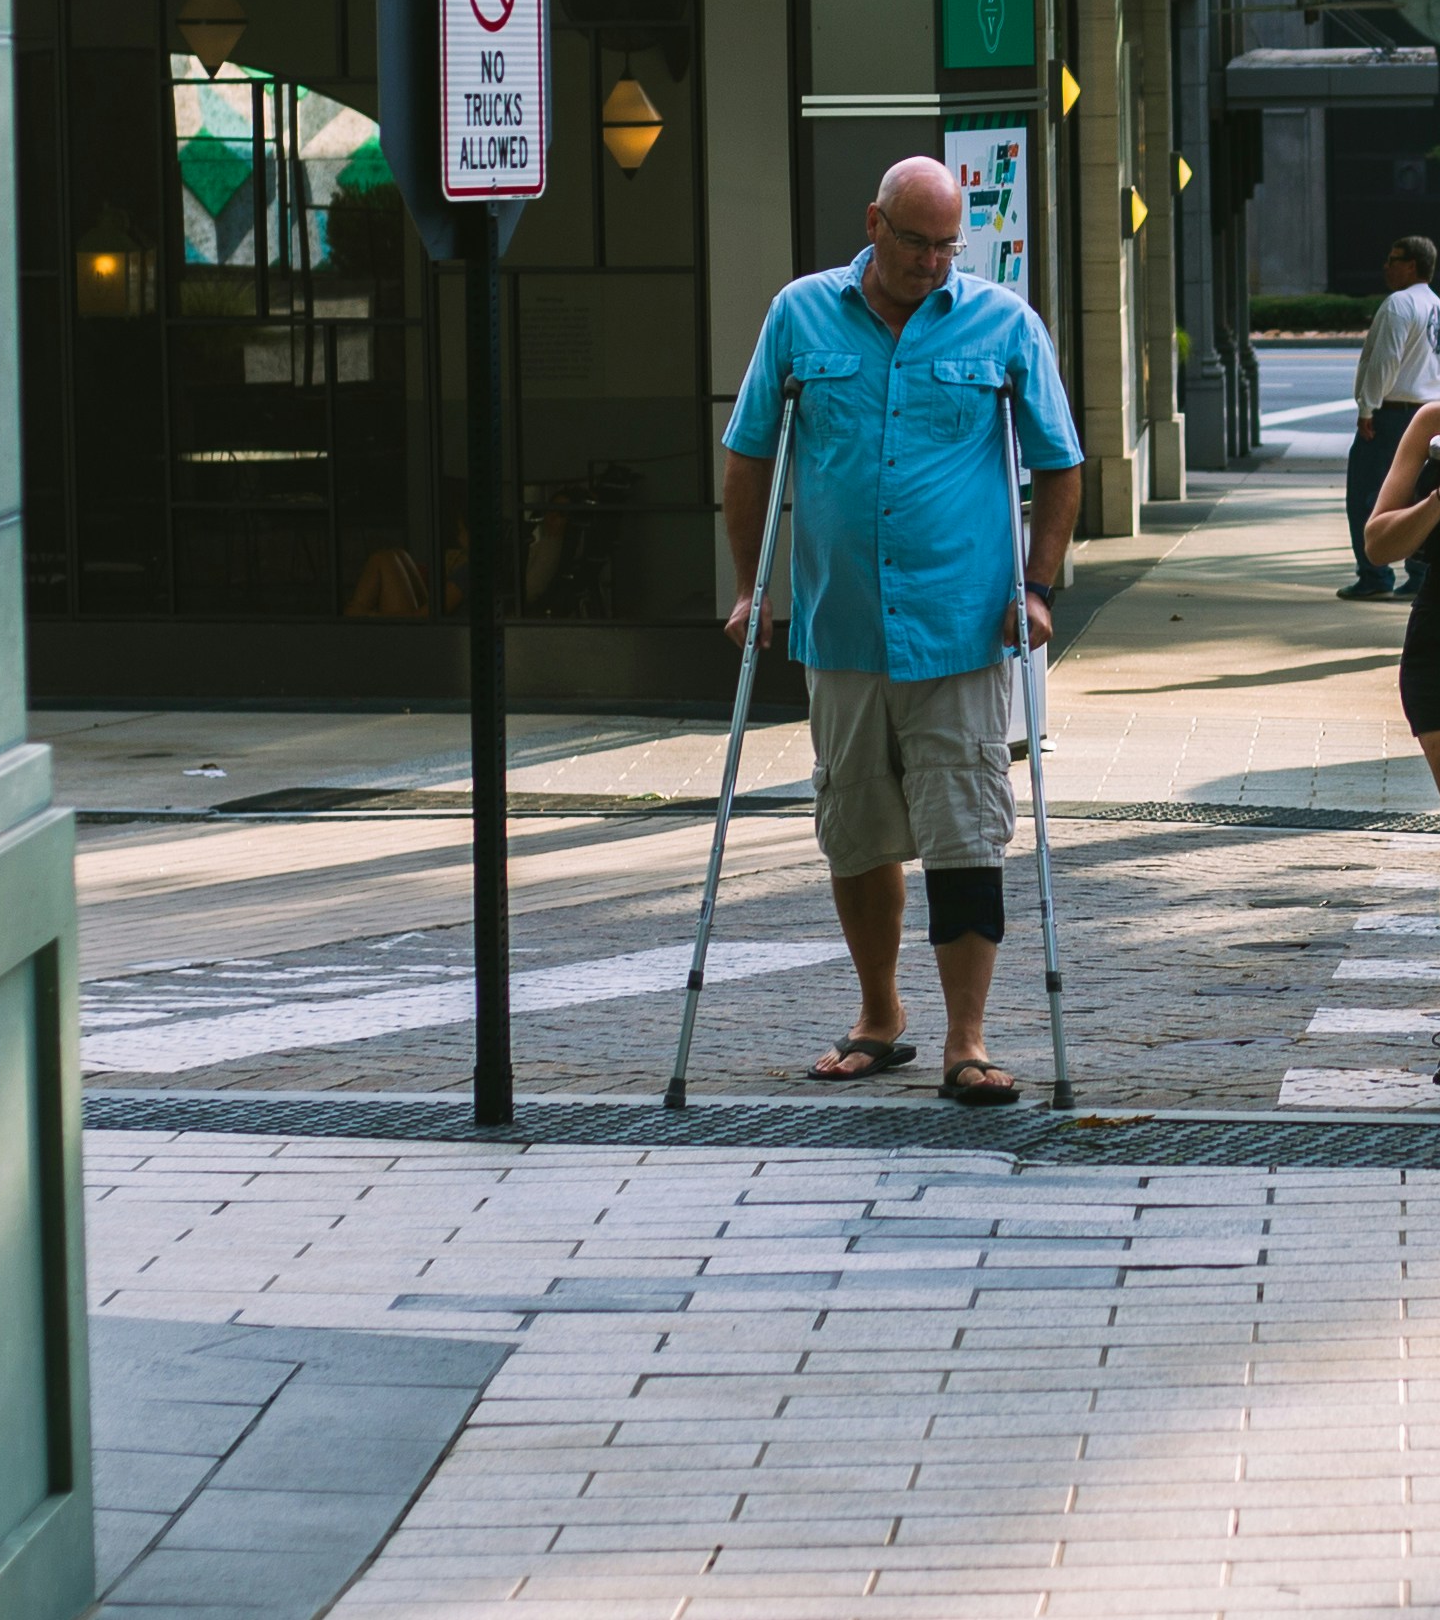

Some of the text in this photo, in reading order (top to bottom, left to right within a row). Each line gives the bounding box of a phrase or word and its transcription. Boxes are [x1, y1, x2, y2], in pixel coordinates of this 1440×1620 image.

[987, 16, 996, 35] V
[481, 50, 505, 84] NO
[464, 92, 523, 127] TRUCKS
[459, 135, 529, 170] ALLOWED
